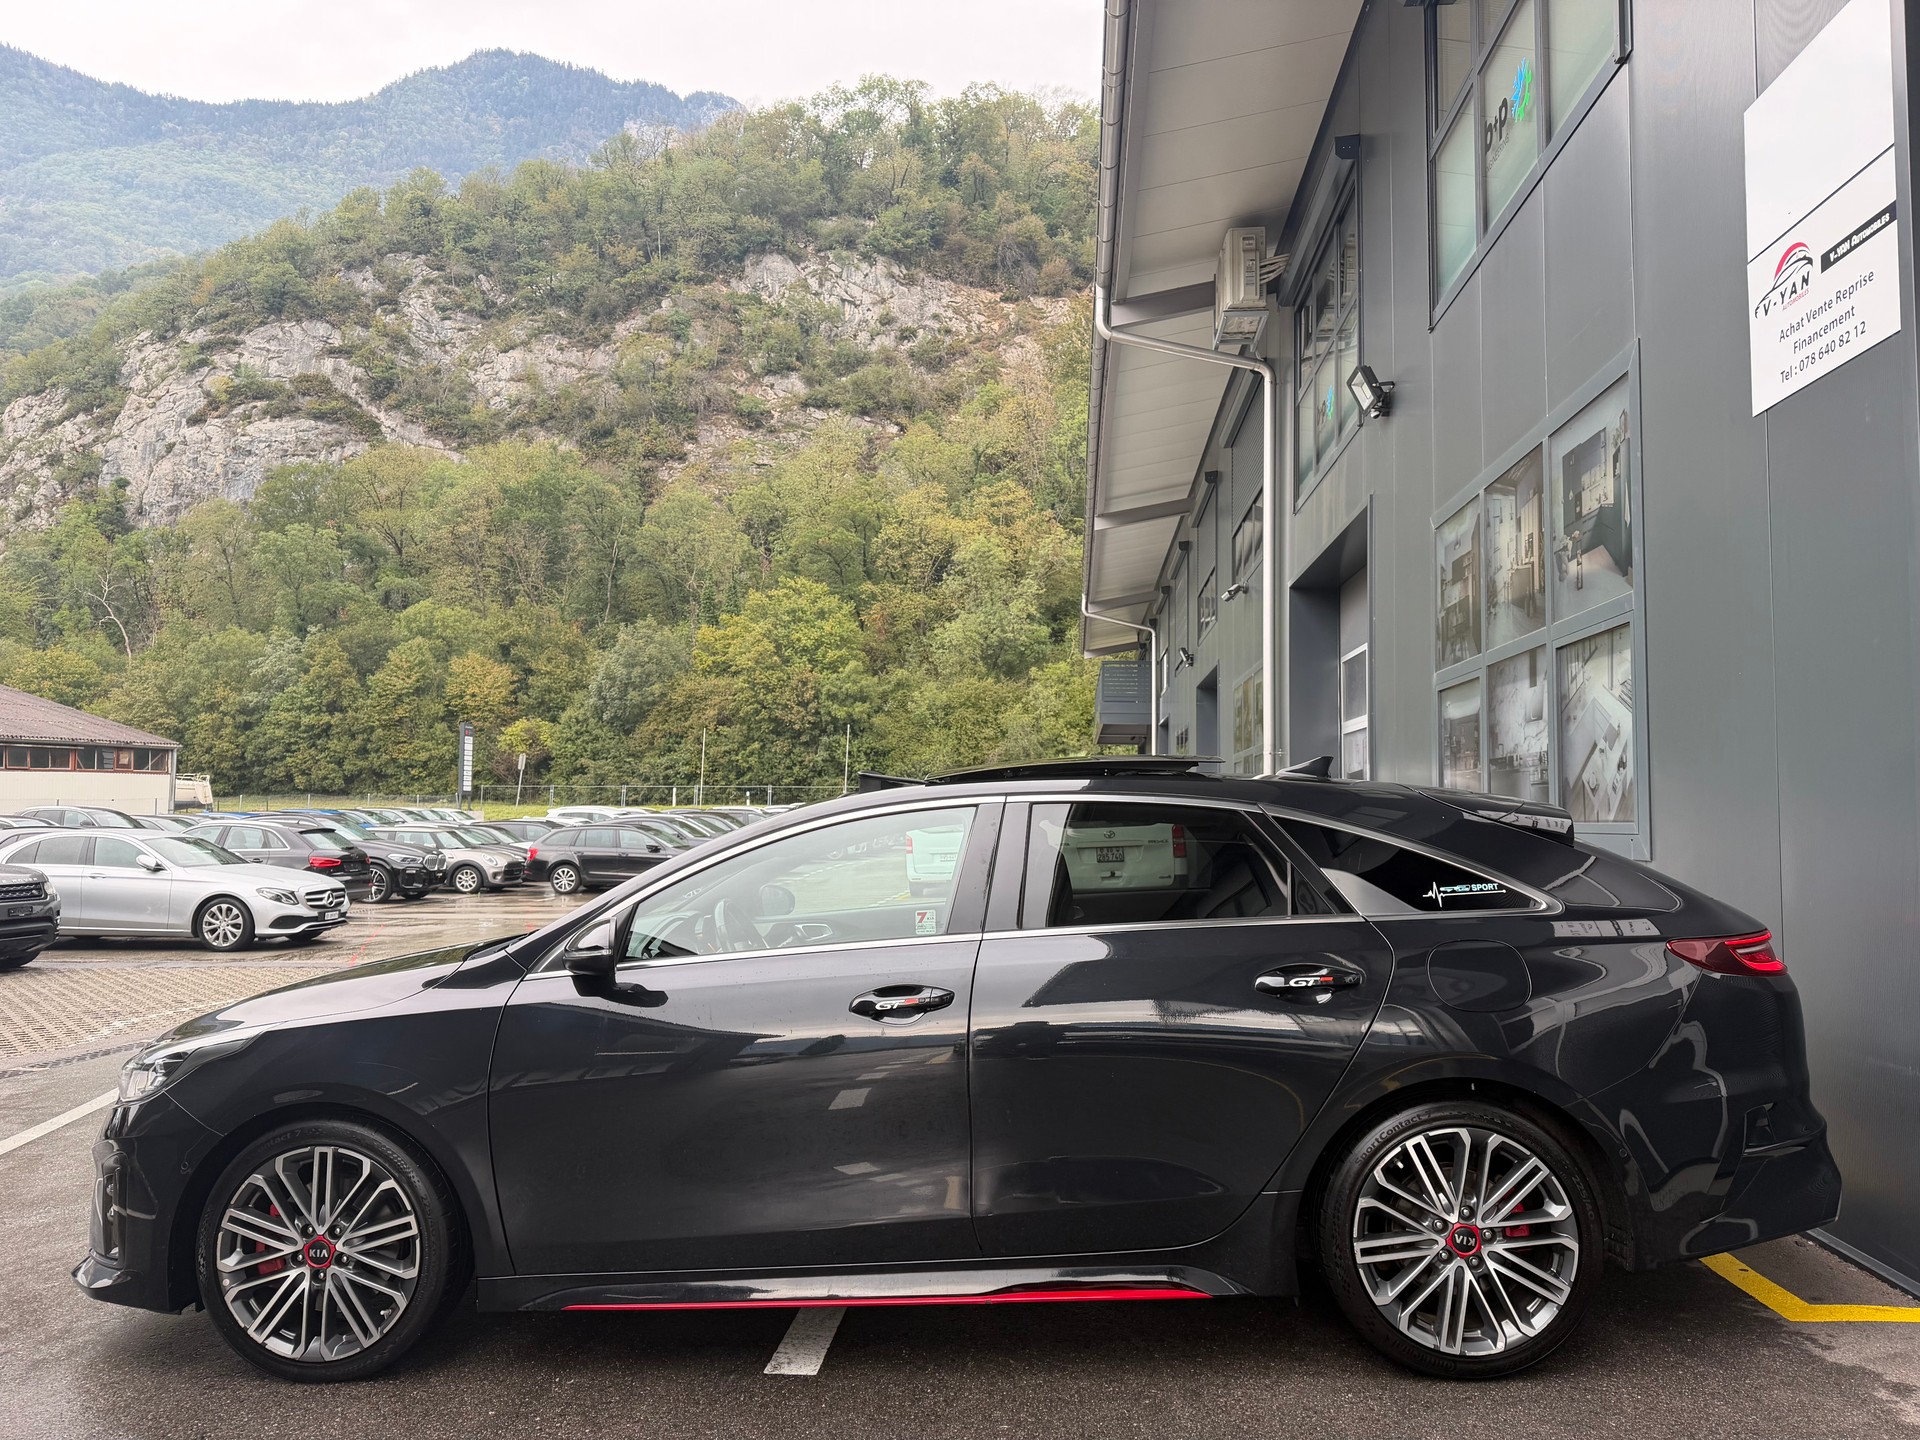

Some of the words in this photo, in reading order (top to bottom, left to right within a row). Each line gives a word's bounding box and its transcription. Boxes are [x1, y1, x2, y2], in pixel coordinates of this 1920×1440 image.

[1829, 239, 1850, 262] V-YAN
[1763, 270, 1810, 317] V-YAN
[1779, 316, 1804, 342] Achat
[1806, 299, 1833, 323] Vente
[1836, 271, 1874, 304] Reprise
[1782, 287, 1810, 311] AUTOMOBILES
[1793, 305, 1855, 354] Financement
[1800, 352, 1816, 372] 078
[1818, 340, 1836, 360] 640
[1838, 330, 1851, 348] 82
[1854, 320, 1866, 338] 12
[1471, 883, 1499, 891] SPORT
[309, 1248, 329, 1258] KIA
